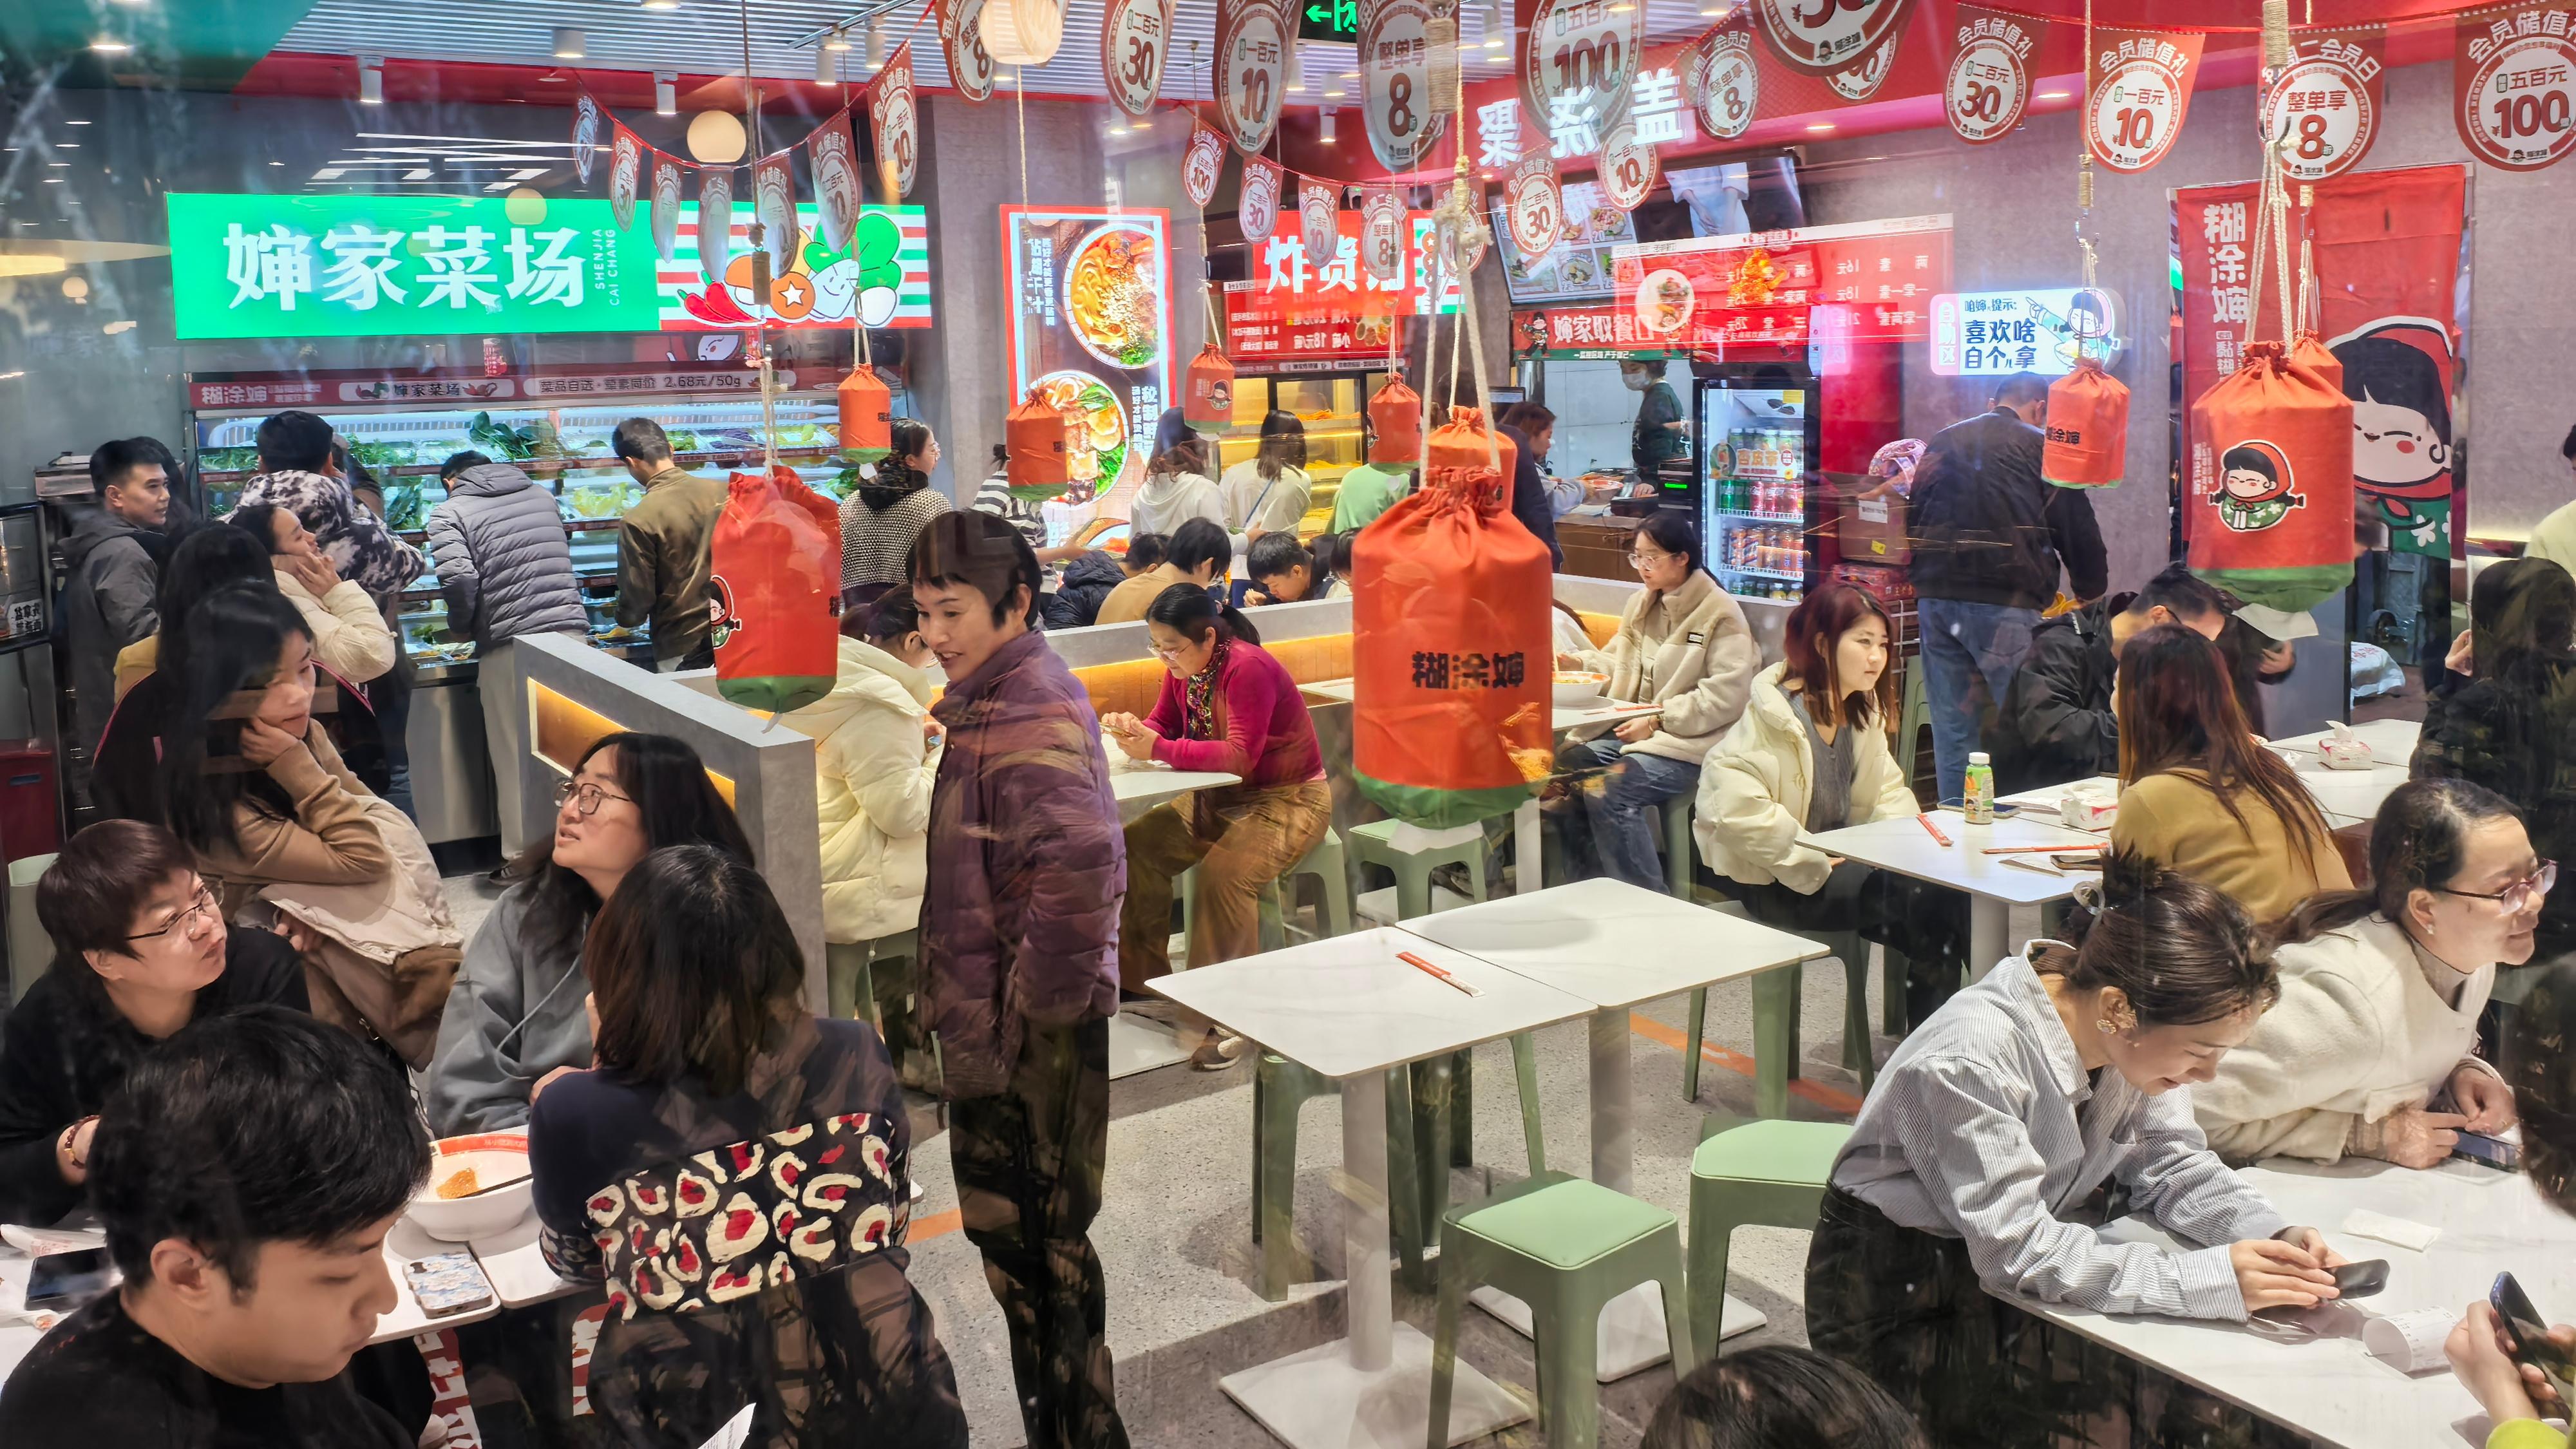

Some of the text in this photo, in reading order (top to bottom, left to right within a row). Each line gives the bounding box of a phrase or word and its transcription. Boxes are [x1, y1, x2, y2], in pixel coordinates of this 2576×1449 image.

[1133, 12, 1159, 37] 二百元
[1957, 17, 2035, 60] 会员储值礼
[1247, 41, 1278, 64] 一百元
[2099, 37, 2189, 78] 会员储值礼
[1973, 63, 2010, 84] 二百元
[2510, 64, 2568, 90] 五百元
[1388, 73, 1412, 137] 8
[2124, 88, 2164, 105] 一百元
[2287, 90, 2347, 113] 整单享
[2296, 114, 2327, 160] 8
[223, 223, 585, 311] 婶家菜场
[592, 229, 604, 290] SHENJIA
[605, 229, 620, 306] CAI CHANG
[2203, 202, 2249, 324] 糊涂婶
[1553, 314, 1655, 345] 婶家取餐口
[1964, 317, 2037, 345] 喜欢啥
[1964, 345, 2038, 370] 自个儿拿
[202, 386, 267, 405] 糊涂婶
[393, 383, 460, 397] 婶家菜场
[663, 375, 741, 388] 2.68元/50g
[1412, 651, 1525, 690] 糊涂婶
